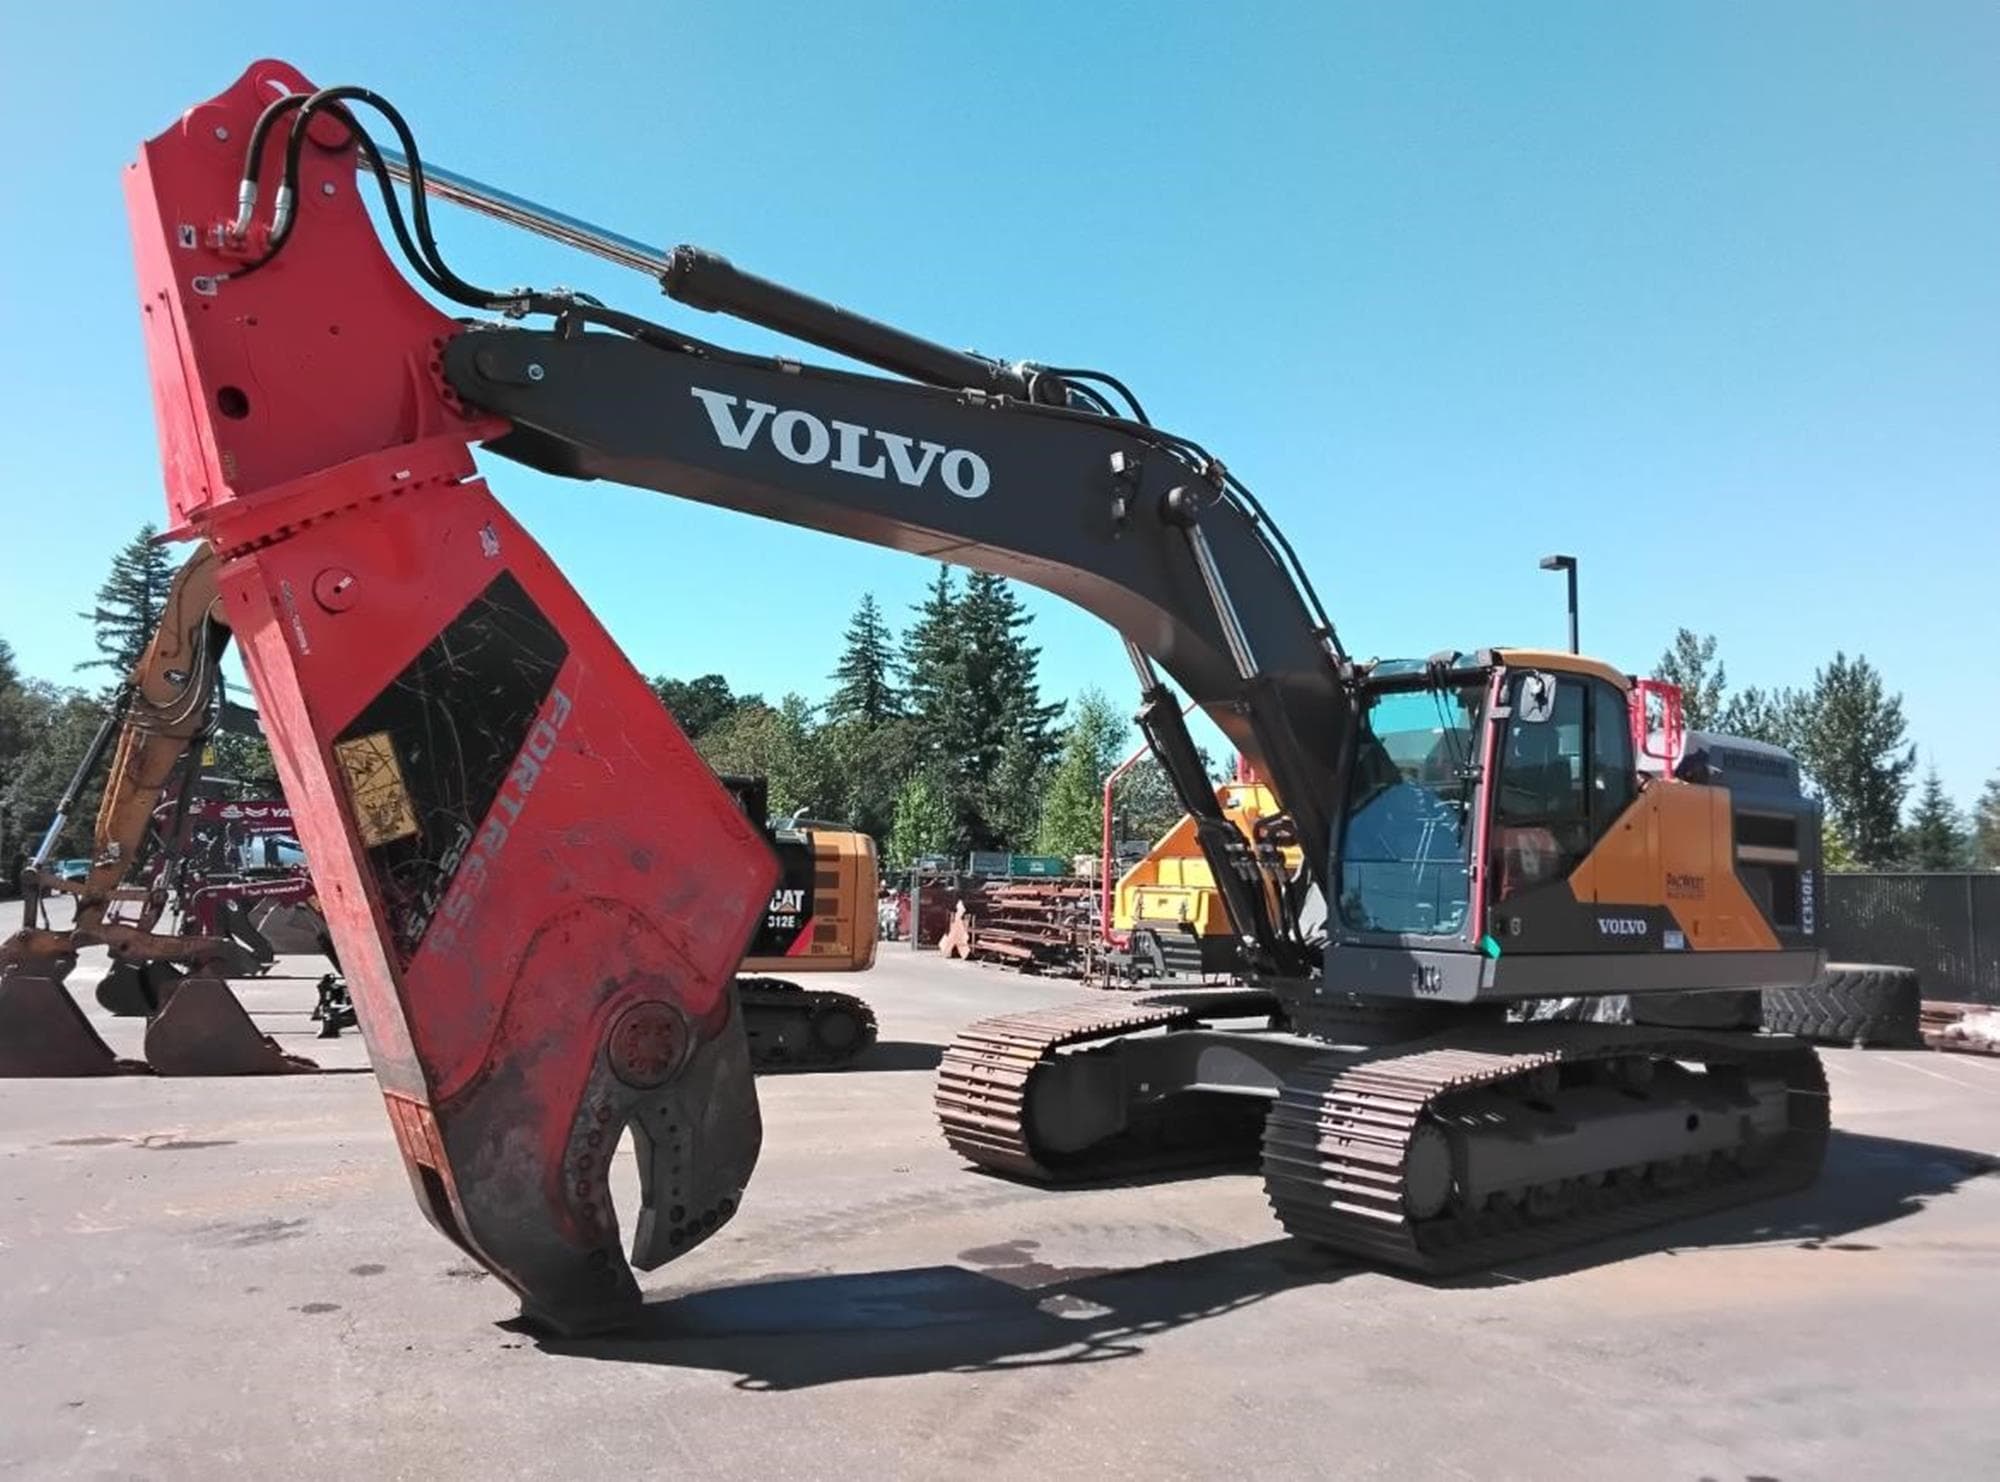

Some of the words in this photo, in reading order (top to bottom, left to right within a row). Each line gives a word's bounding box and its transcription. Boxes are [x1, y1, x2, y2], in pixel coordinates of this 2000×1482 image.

[691, 386, 990, 499] VOLVO
[429, 688, 573, 952] FORTRESS
[769, 890, 805, 912] CAT
[1598, 918, 1647, 935] VOLVO
